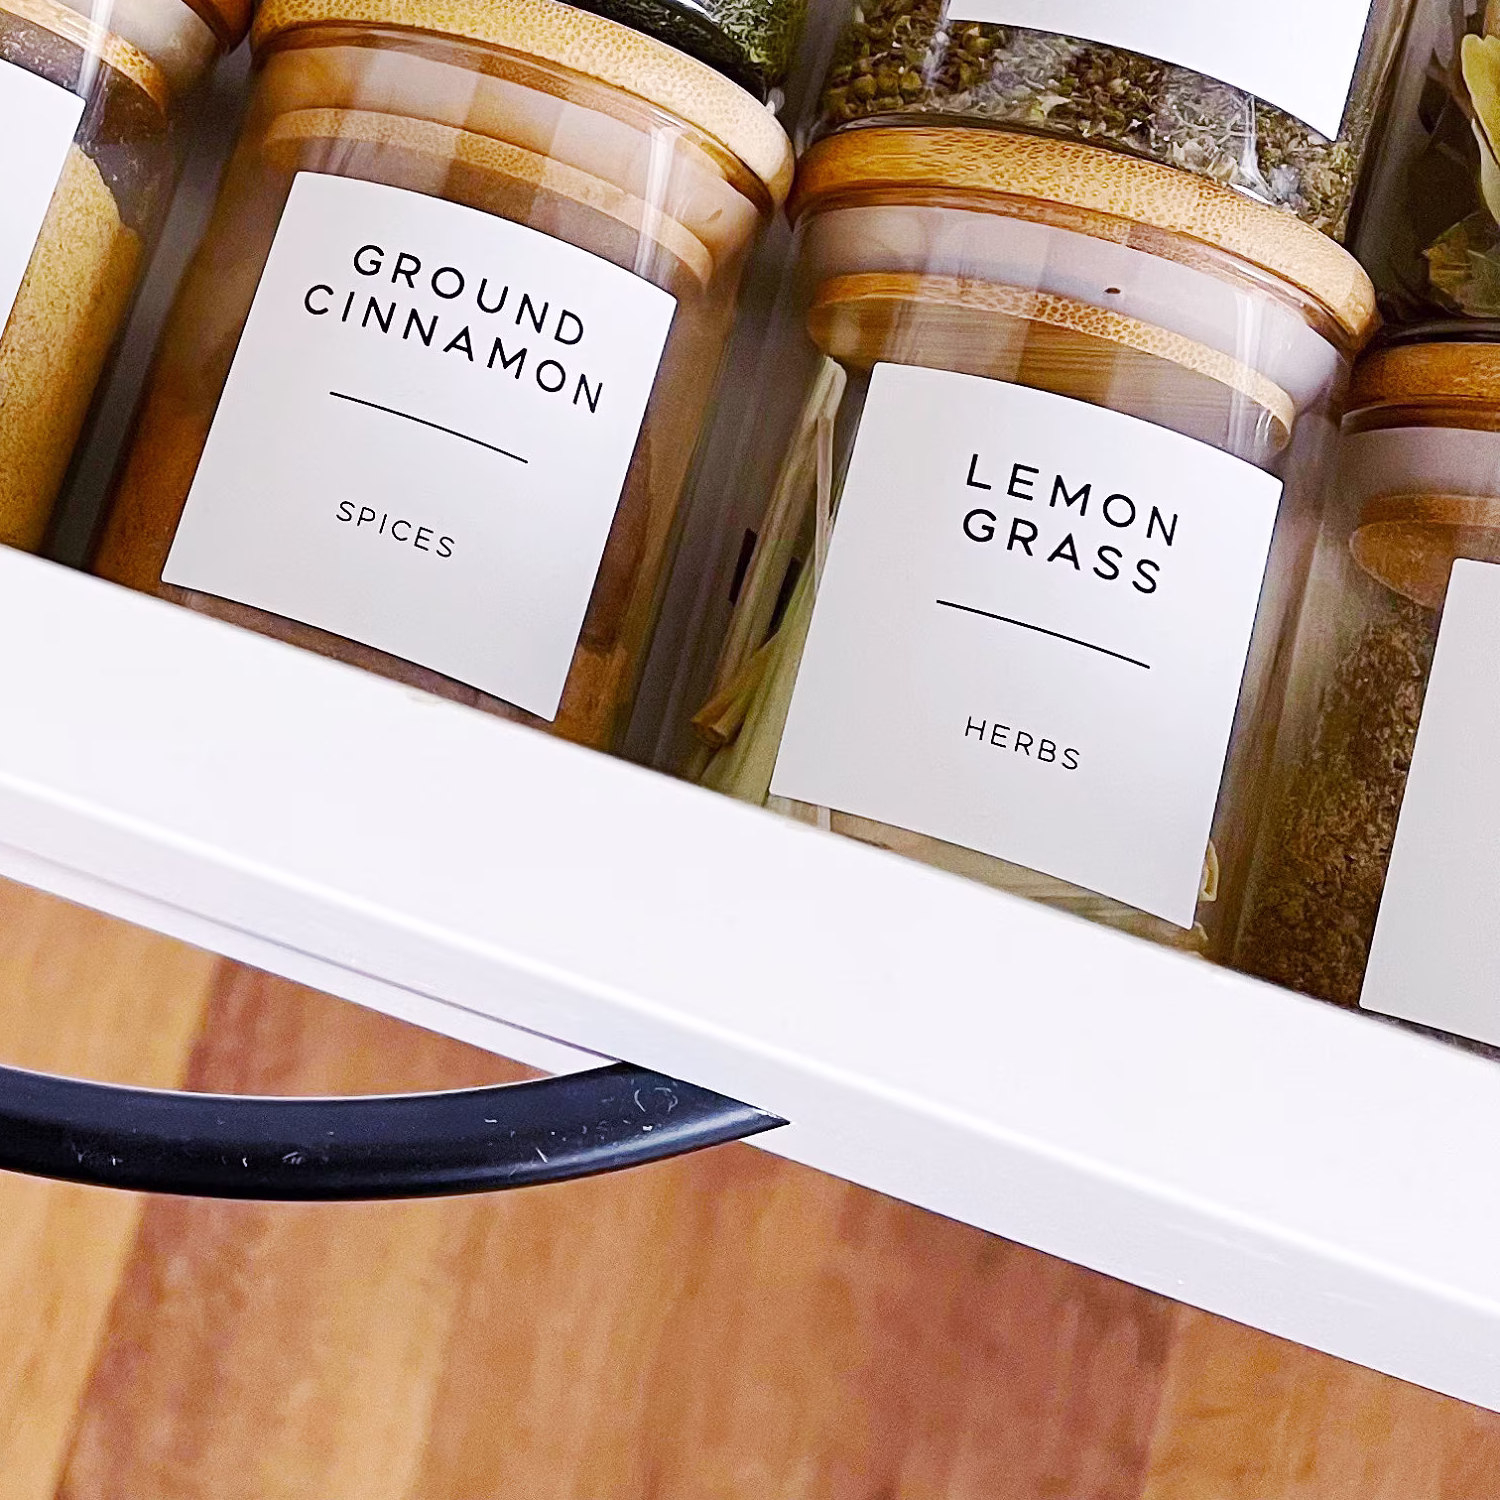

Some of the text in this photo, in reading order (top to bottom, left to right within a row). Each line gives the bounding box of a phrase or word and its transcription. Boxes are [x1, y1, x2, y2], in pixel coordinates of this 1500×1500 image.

[353, 244, 584, 346] GROUND
[303, 283, 604, 414] CINNAMON
[335, 500, 456, 559] SPICES
[965, 453, 1179, 547] LEMON
[962, 508, 1161, 595] GRASS
[964, 715, 1081, 771] HERBS
